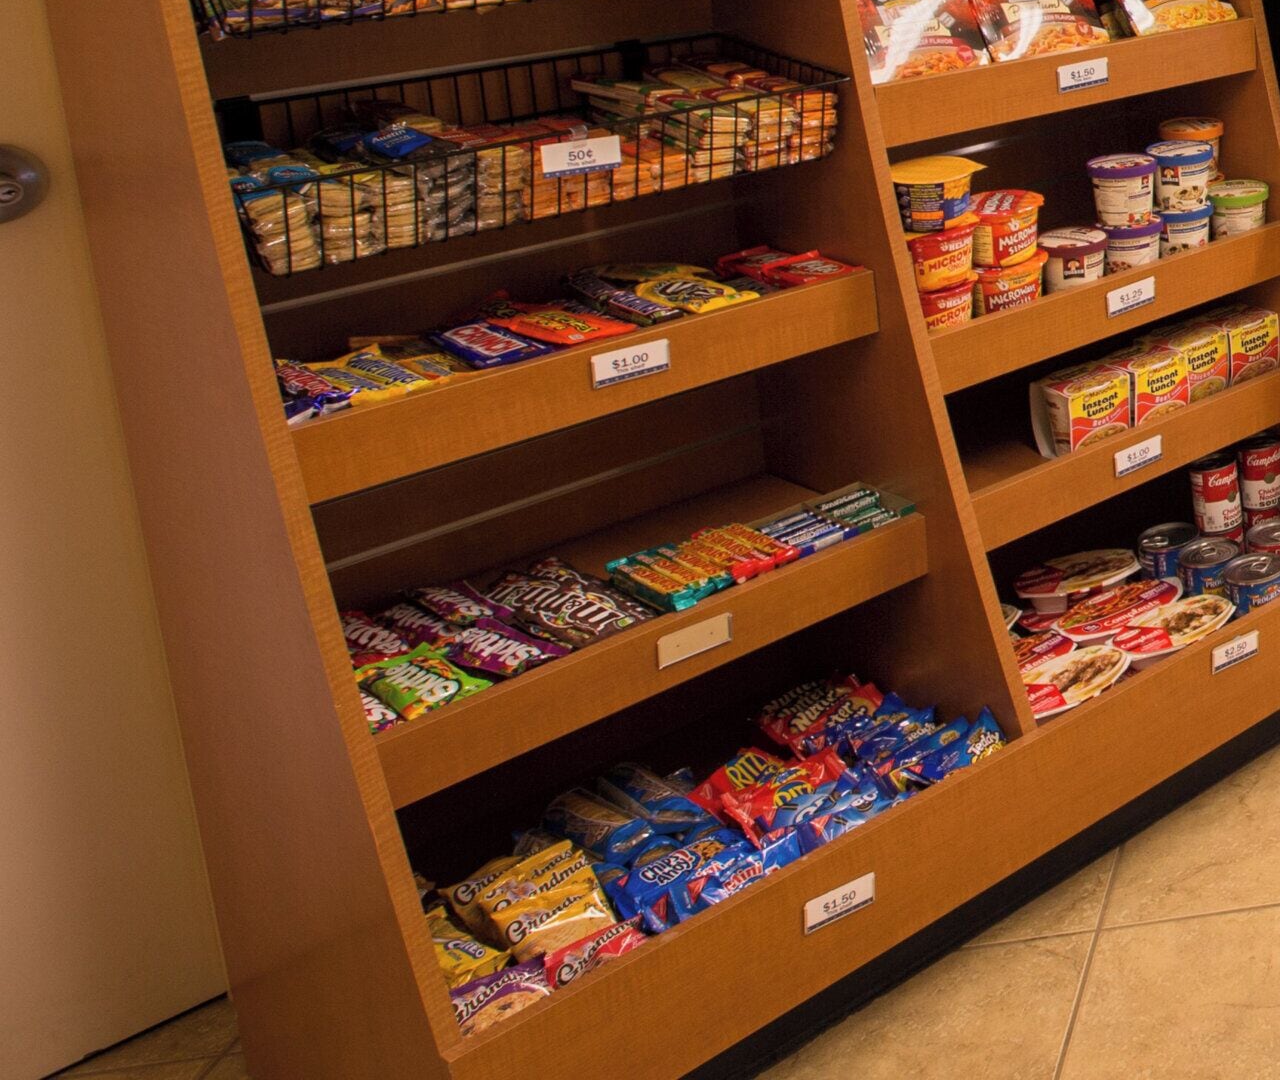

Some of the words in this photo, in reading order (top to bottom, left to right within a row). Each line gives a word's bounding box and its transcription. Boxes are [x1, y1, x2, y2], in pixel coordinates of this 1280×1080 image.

[1070, 67, 1096, 80] $1.50
[371, 128, 406, 144] Austin
[1118, 289, 1143, 304] $1.25
[453, 325, 525, 354] CRUNCH
[1239, 331, 1271, 348] Instant
[1242, 339, 1268, 354] Lunch
[611, 352, 649, 370] $1.00
[1187, 348, 1218, 366] Instant
[1187, 356, 1216, 373] Lunch
[1146, 370, 1179, 388] Instant
[1150, 379, 1177, 395] Lunch
[1081, 393, 1119, 411] Instant
[1086, 402, 1116, 419] Lunch
[1126, 445, 1150, 462] $1.00
[1224, 641, 1248, 658] $2.50
[968, 731, 1000, 757] Teddy
[726, 752, 769, 790] RITZ
[640, 853, 680, 883] Chips
[822, 888, 857, 914] $1.50
